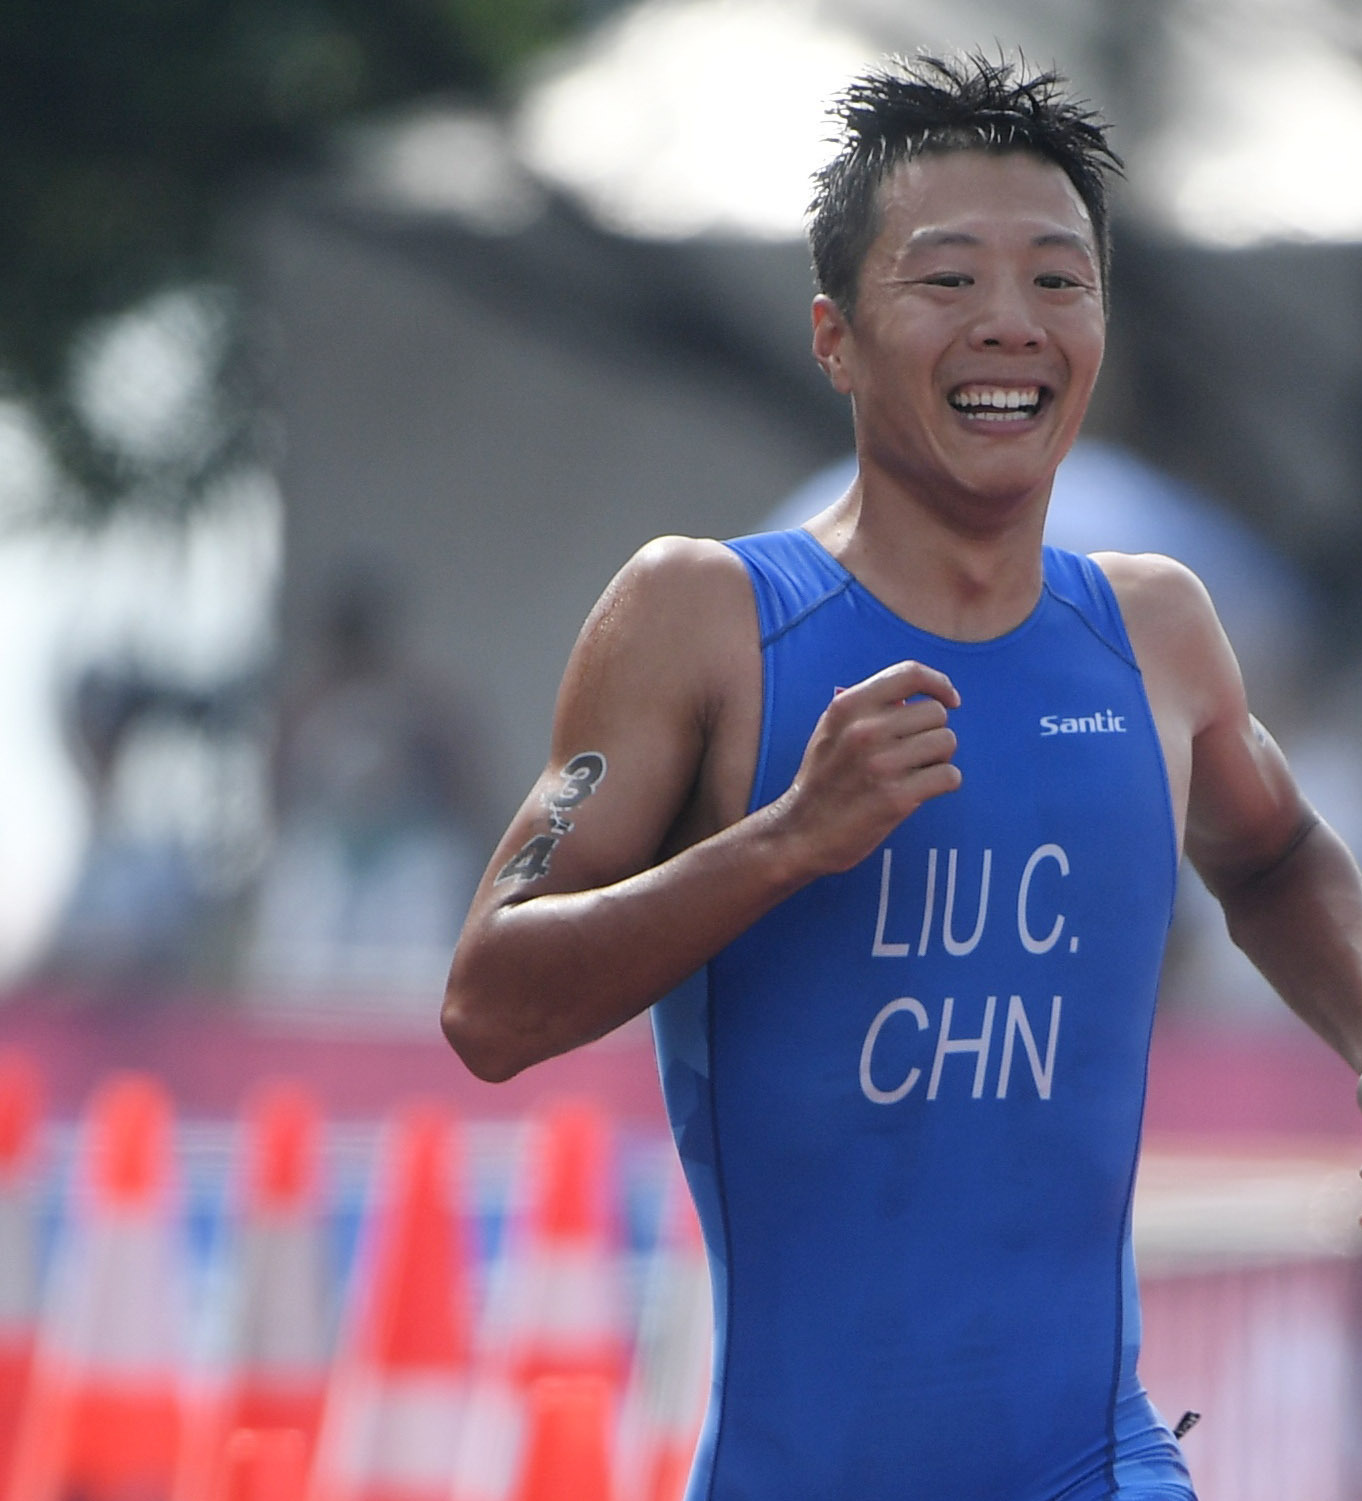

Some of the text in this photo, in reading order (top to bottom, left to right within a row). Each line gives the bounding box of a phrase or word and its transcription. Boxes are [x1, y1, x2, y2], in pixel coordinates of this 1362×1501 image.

[1040, 708, 1127, 736] Santic
[871, 843, 1080, 957] LIU C.
[859, 995, 1063, 1105] CHN
